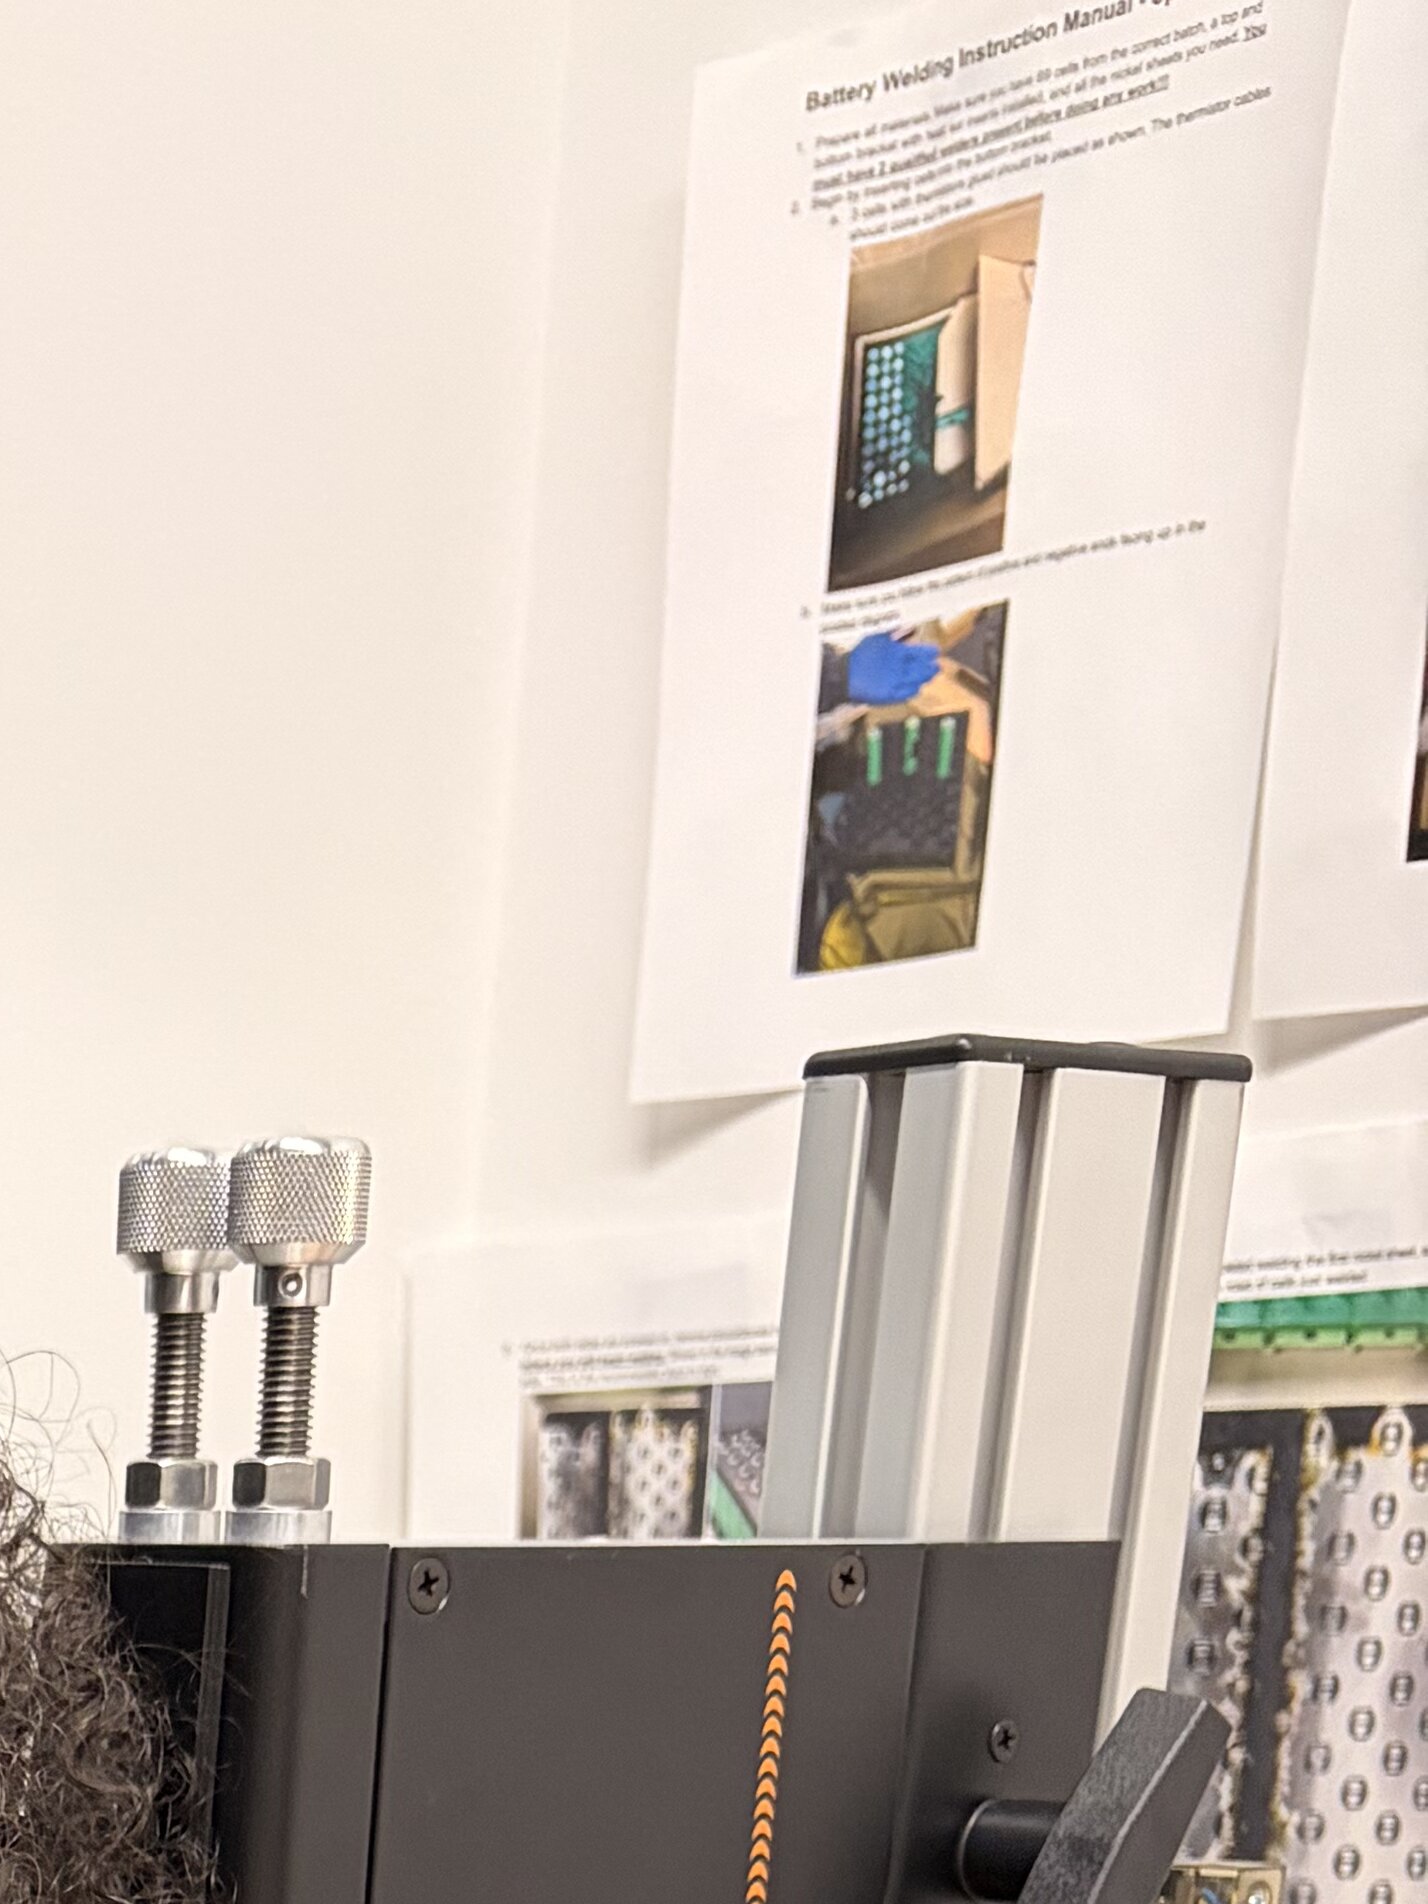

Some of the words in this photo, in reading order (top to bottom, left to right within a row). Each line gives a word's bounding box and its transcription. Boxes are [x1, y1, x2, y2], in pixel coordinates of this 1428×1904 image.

[806, 81, 877, 112] Battery
[883, 56, 953, 91] Welding
[958, 21, 1058, 68] Instruction
[1063, 0, 1133, 32] Manual
[1111, 48, 1128, 60] the
[1186, 44, 1206, 61] you
